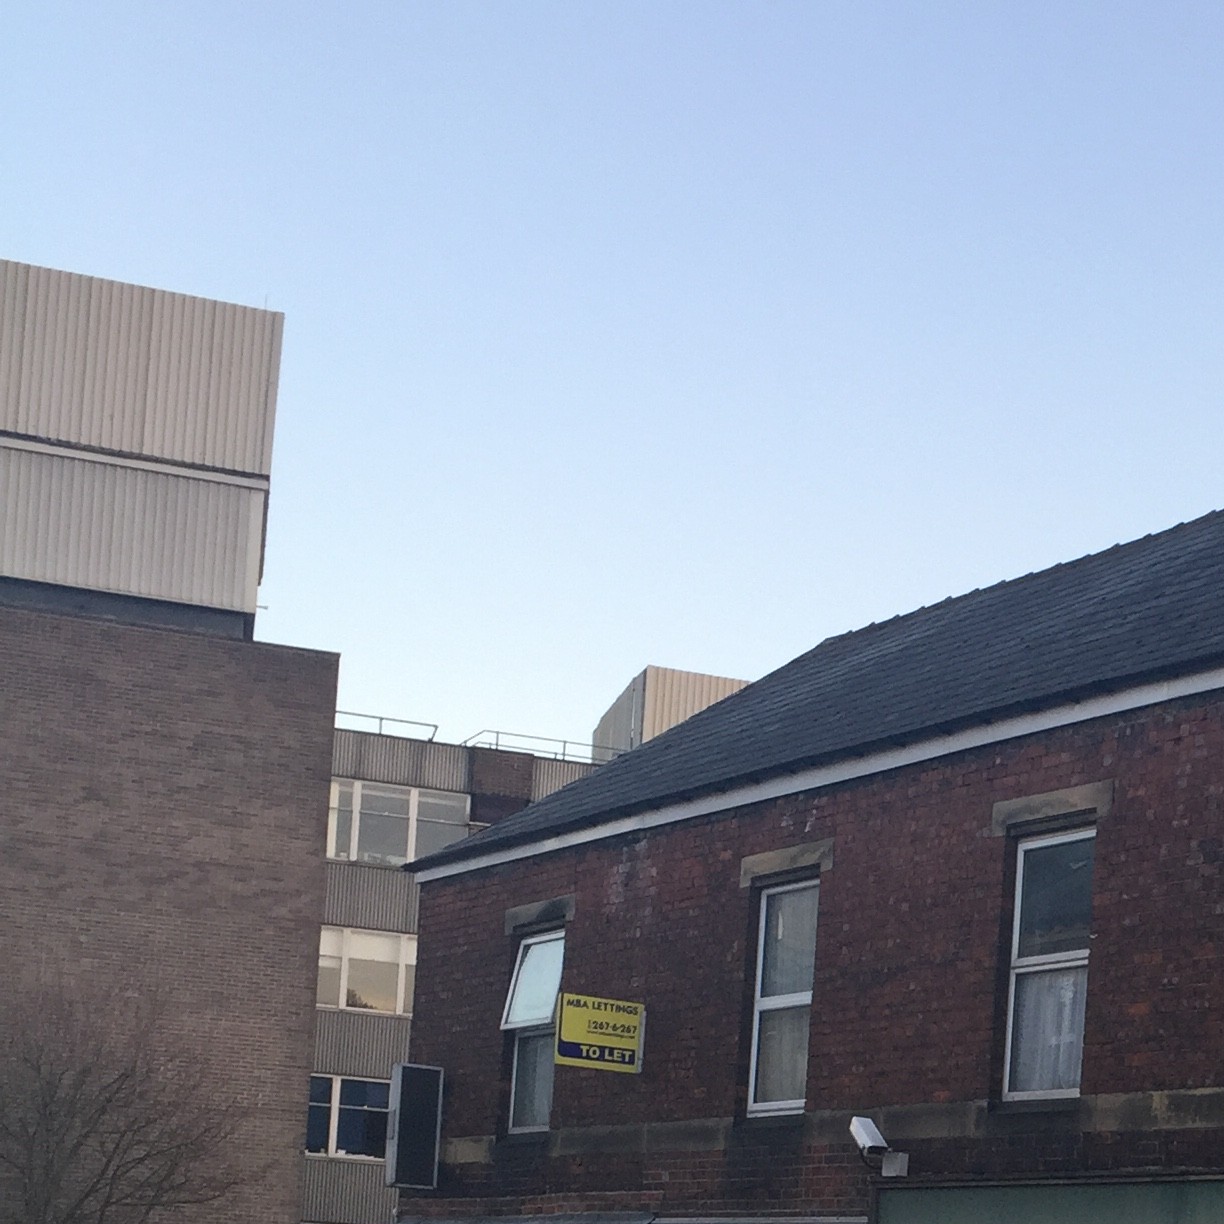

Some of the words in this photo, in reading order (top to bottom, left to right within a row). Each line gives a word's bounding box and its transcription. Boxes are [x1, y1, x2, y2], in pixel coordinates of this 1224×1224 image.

[566, 998, 589, 1010] MBA
[592, 1001, 640, 1016] LETTINGS
[580, 1045, 600, 1059] TO
[604, 1048, 633, 1063] LET
